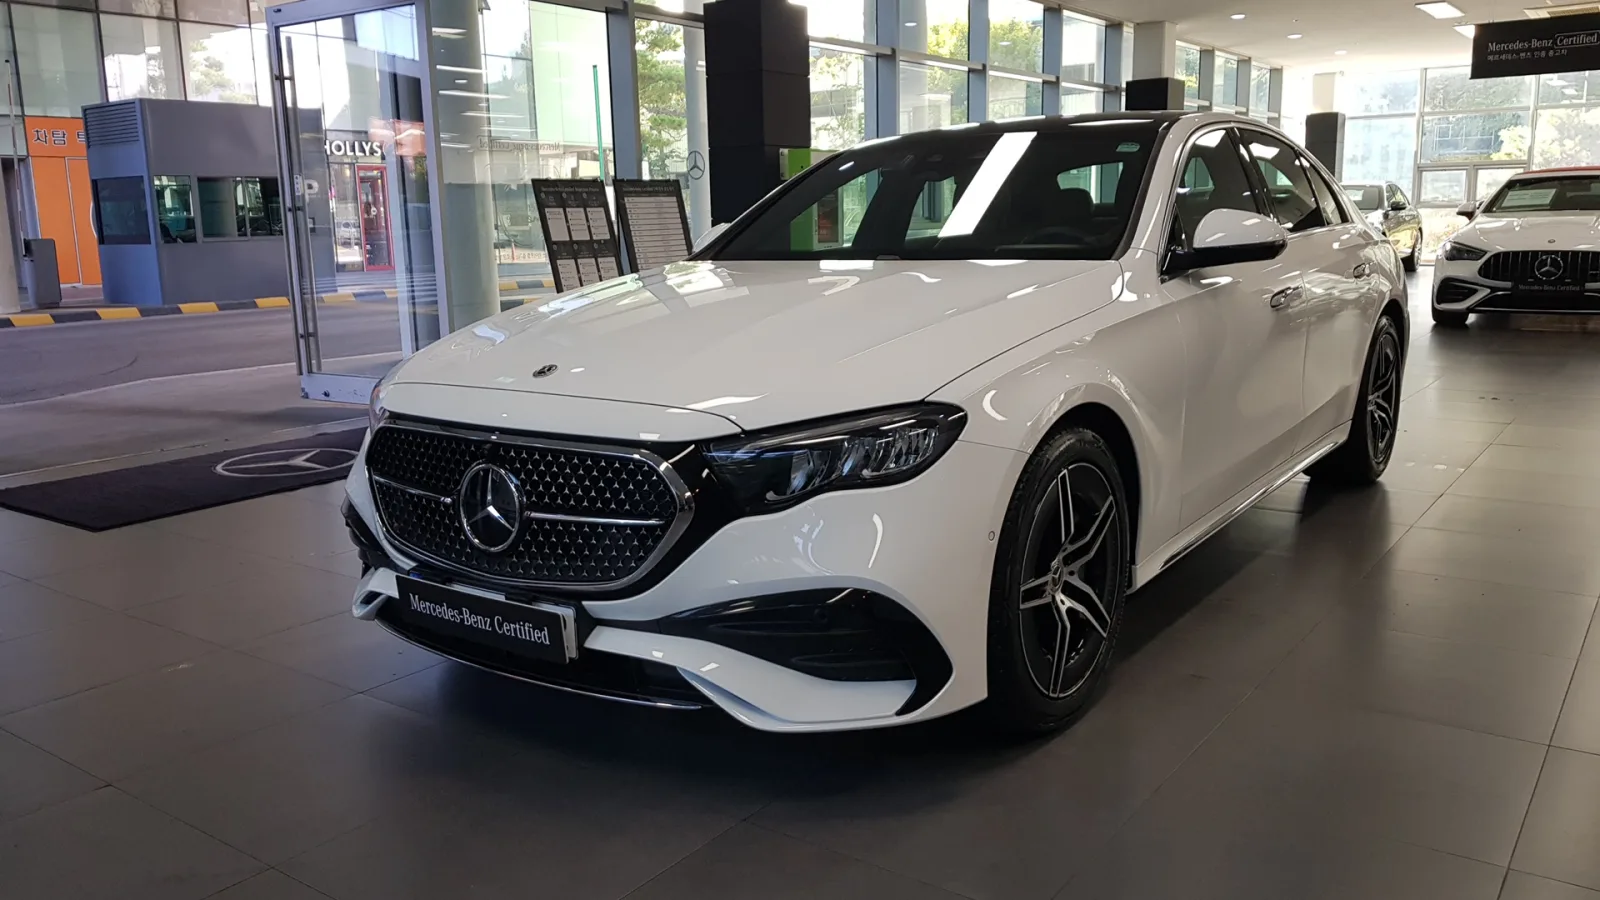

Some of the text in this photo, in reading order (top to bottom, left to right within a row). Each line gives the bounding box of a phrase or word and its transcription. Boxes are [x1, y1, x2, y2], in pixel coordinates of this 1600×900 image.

[1488, 33, 1598, 52] Mercedes-Benz Certified
[409, 592, 550, 645] Mercedes-Benz Certified
